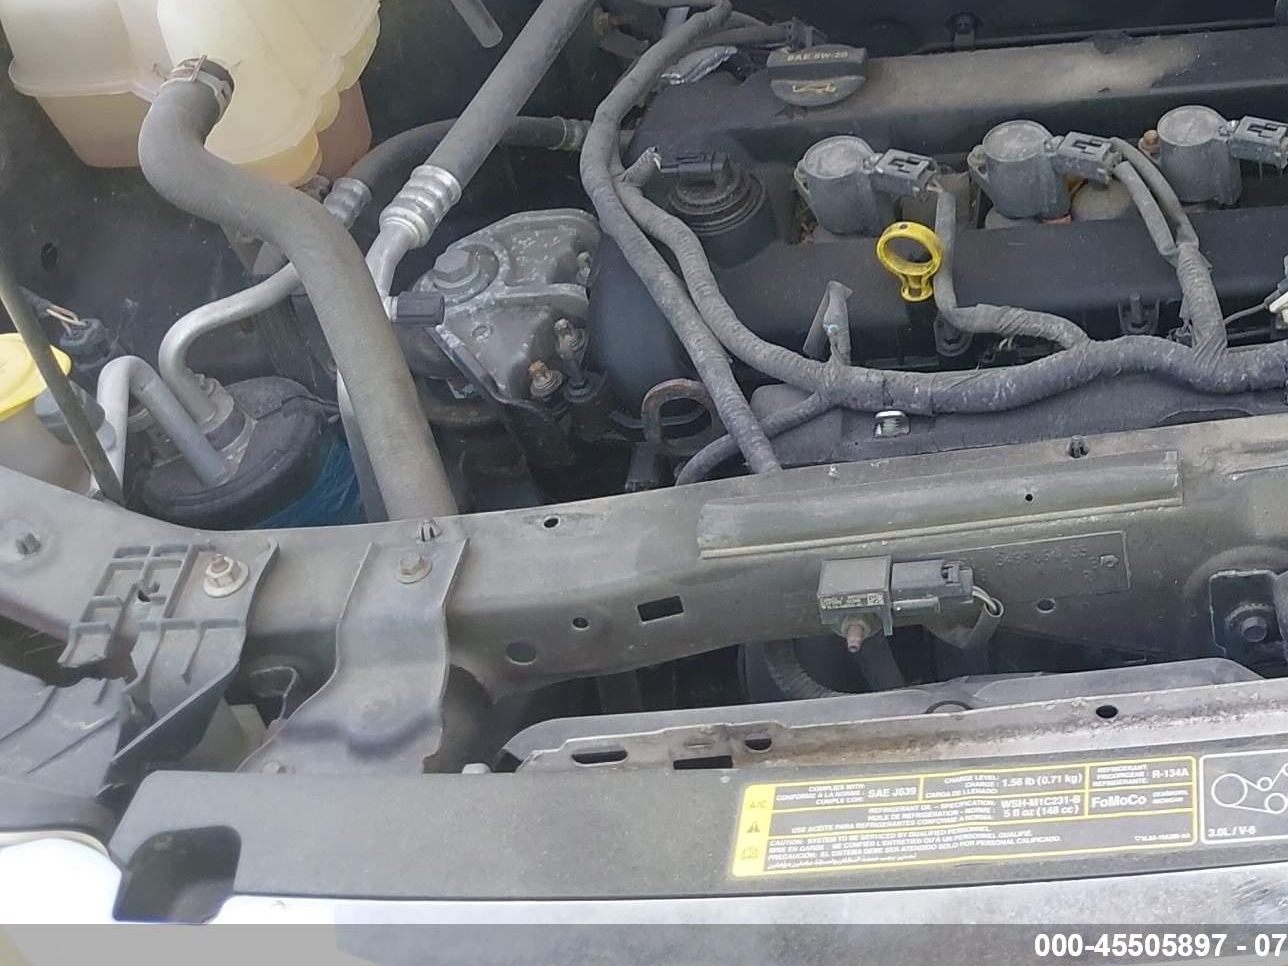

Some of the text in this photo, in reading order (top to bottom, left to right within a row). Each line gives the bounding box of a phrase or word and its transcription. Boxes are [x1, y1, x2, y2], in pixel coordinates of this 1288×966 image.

[1025, 777, 1035, 786] lb
[1036, 775, 1062, 786] (0.71
[1064, 773, 1083, 784] kg)
[1152, 768, 1190, 779] R-134A
[868, 786, 917, 798] SAE J639
[1092, 794, 1147, 809] FoMoCo
[1004, 810, 1010, 818] 5
[1022, 809, 1034, 817] oz
[1062, 804, 1080, 815] cc)
[1208, 828, 1231, 837] 3.0L
[1238, 825, 1256, 835] V-6
